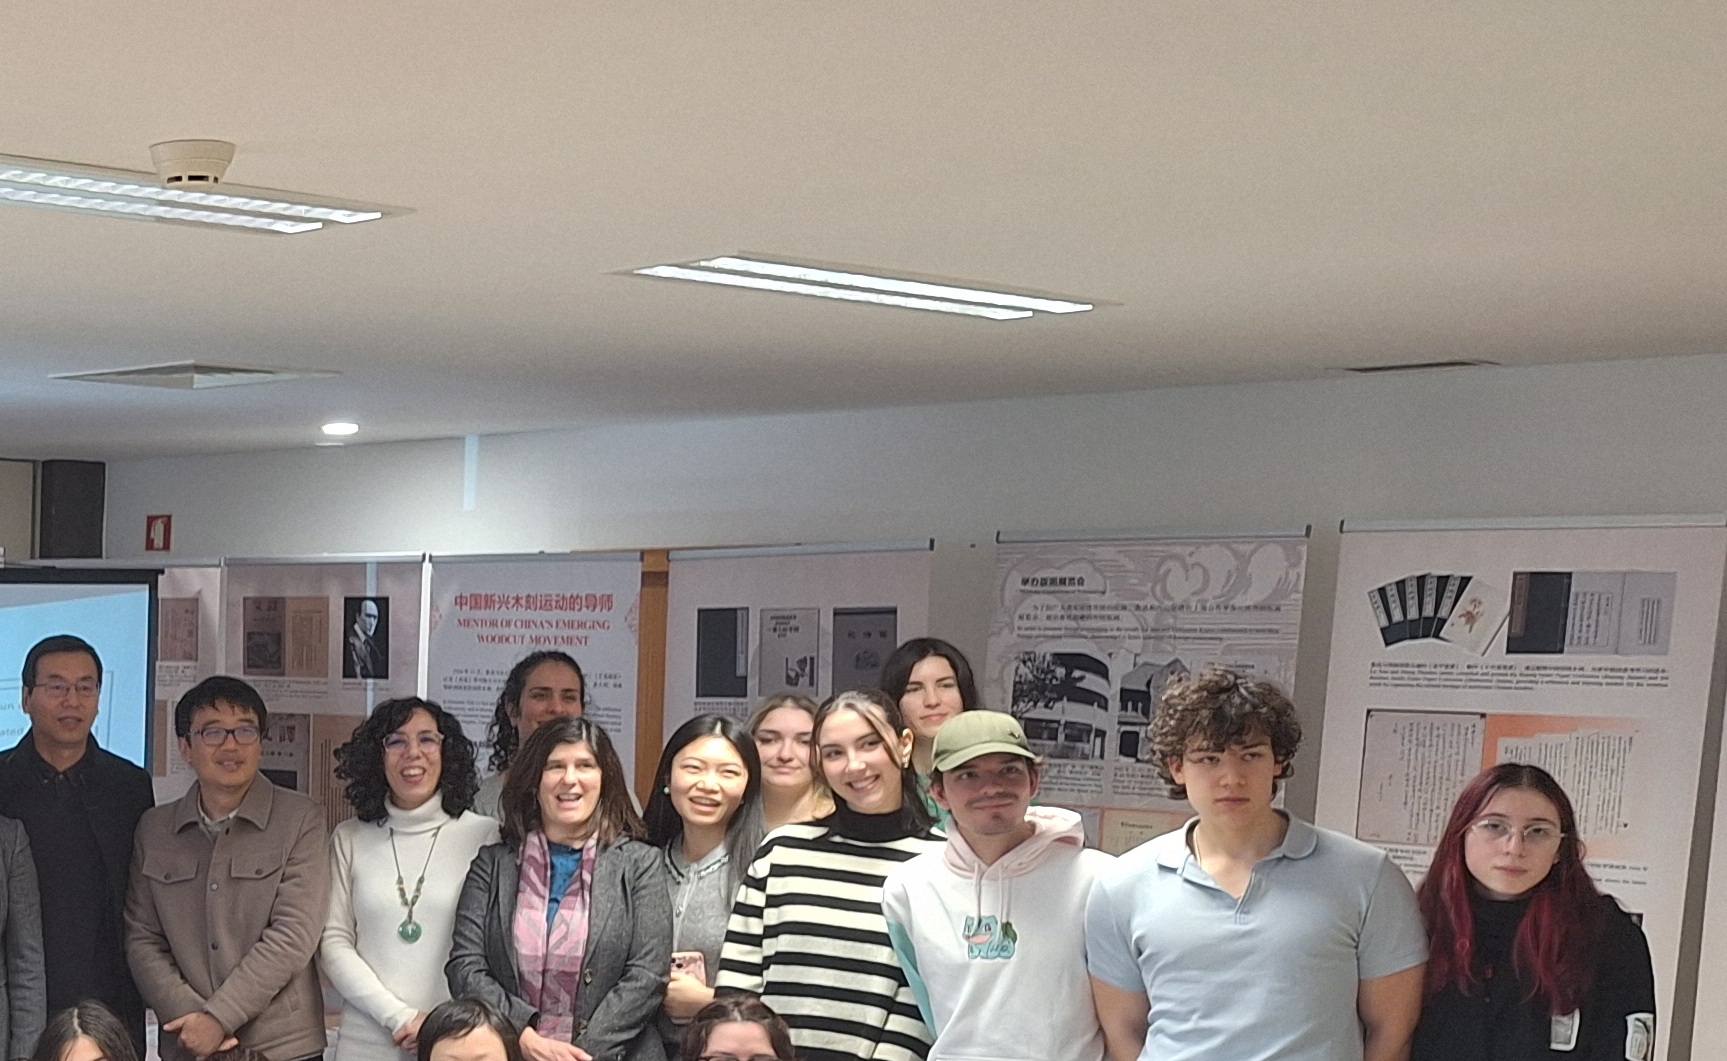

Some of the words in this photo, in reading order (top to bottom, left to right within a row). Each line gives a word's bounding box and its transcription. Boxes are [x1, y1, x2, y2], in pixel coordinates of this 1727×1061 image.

[454, 592, 614, 613] 中国新兴木刻运动的导师
[457, 618, 498, 629] MENTOR
[500, 619, 513, 629] OF
[555, 619, 610, 631] EMERGING
[476, 634, 525, 645] WOODCUT
[530, 635, 589, 647] MOVEMENT
